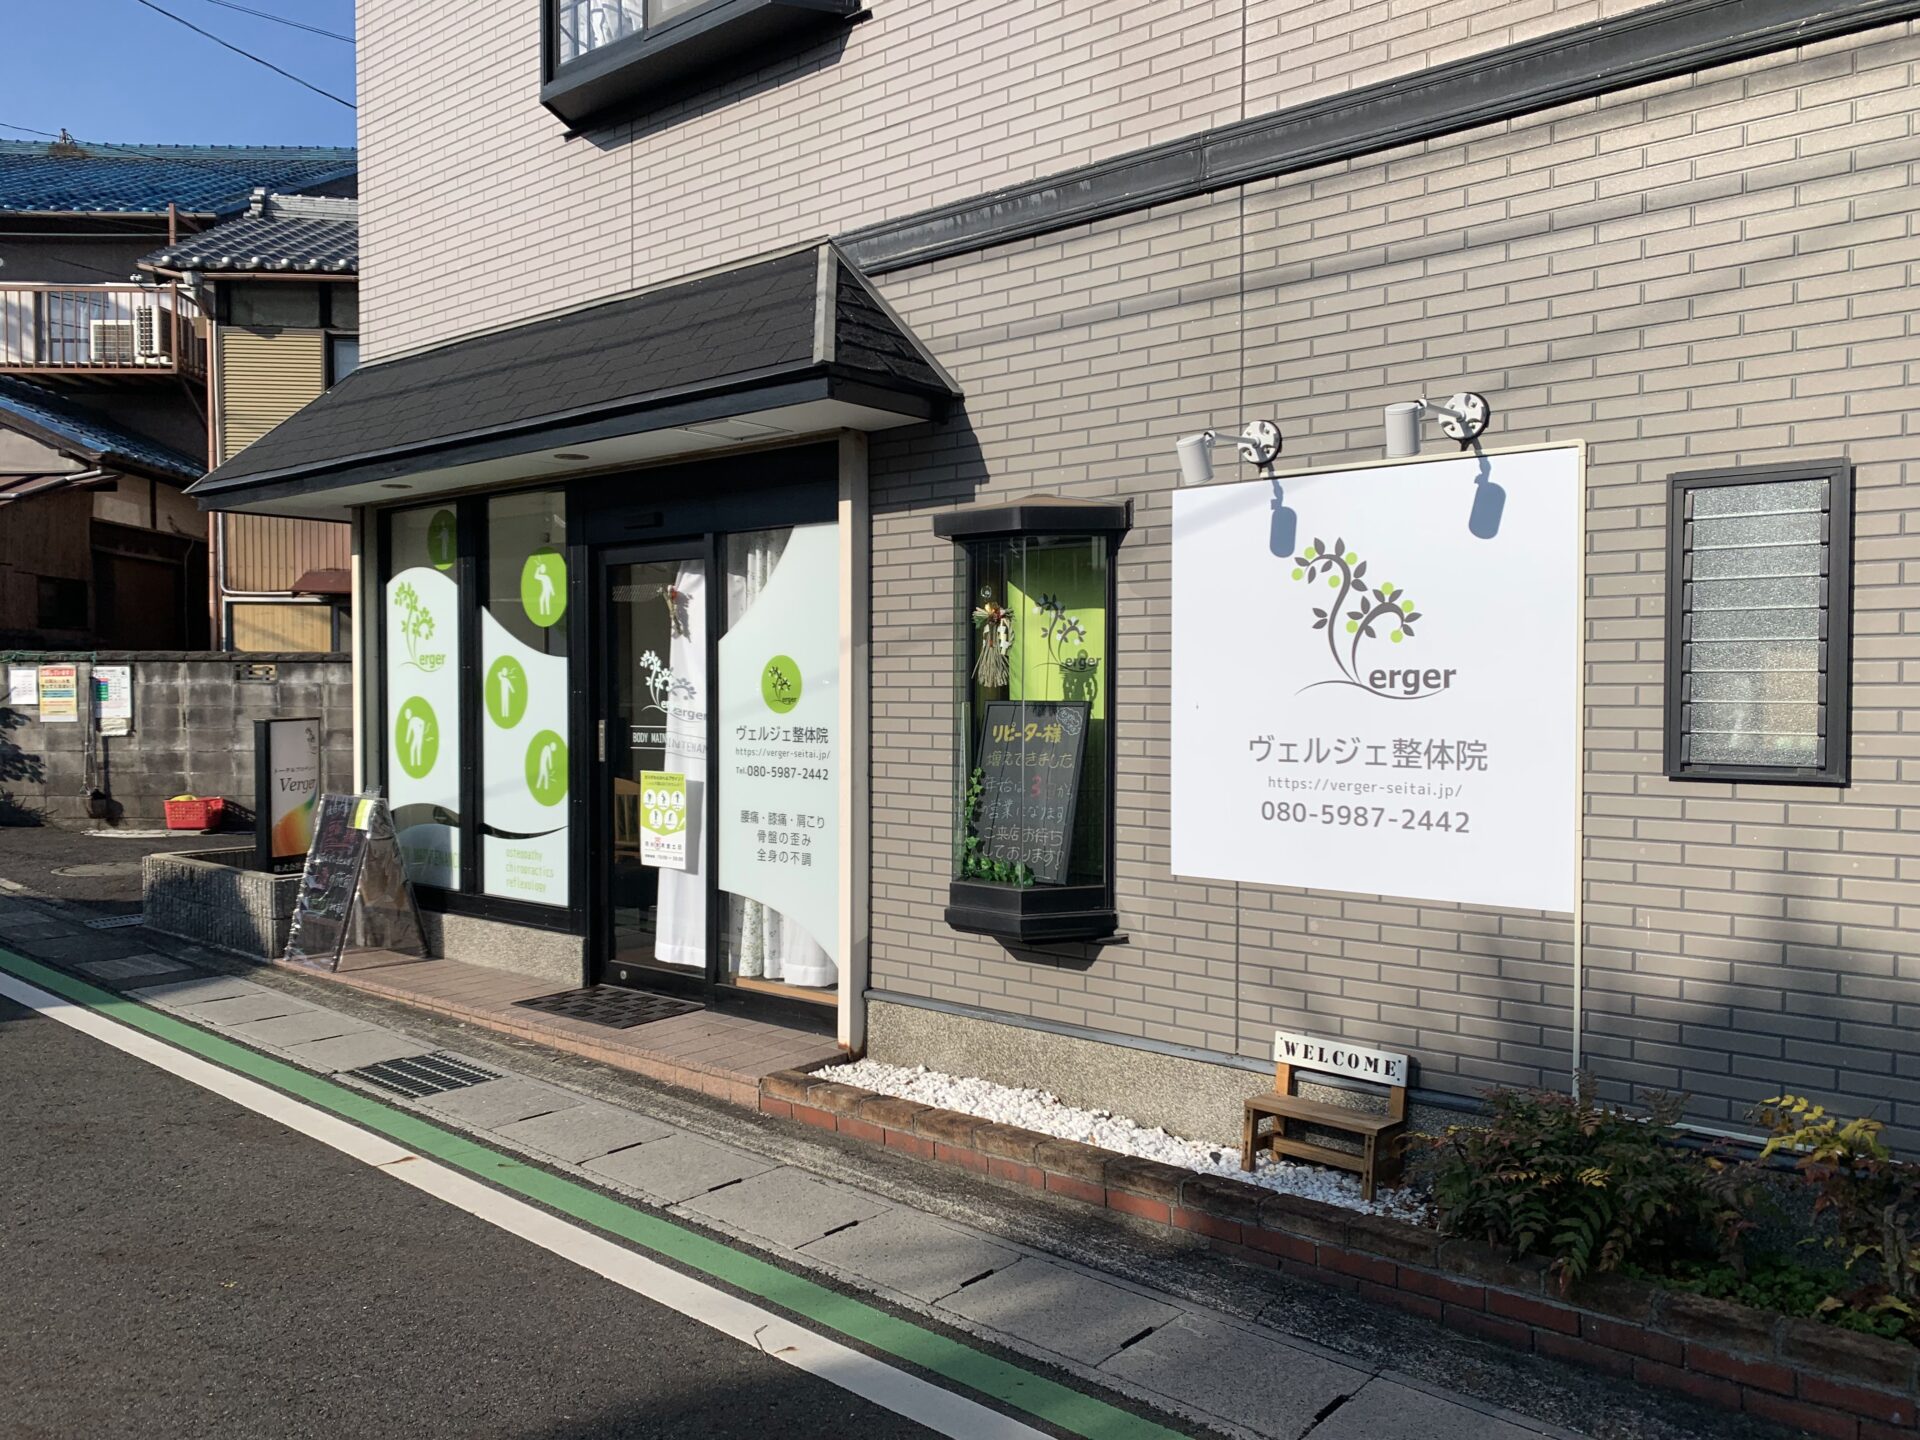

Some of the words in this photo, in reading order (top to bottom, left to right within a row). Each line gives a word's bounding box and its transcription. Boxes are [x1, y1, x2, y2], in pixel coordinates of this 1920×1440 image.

[419, 654, 446, 668] erger
[1065, 657, 1102, 670] erger
[1368, 666, 1457, 695] erger
[736, 725, 829, 744] ヴェルジェ整体院
[992, 721, 1063, 744] リピーター様
[735, 746, 831, 761] https://verger-seitai.jp/
[1248, 734, 1488, 772] ヴェルジェ整体院
[1268, 776, 1463, 799] https://verger-seitai.jp/
[1261, 801, 1471, 834] 080-5987-2442
[756, 829, 812, 847] 骨盤の歪み
[756, 848, 812, 867] 全身の不調
[1284, 1040, 1397, 1077] WELCOME
